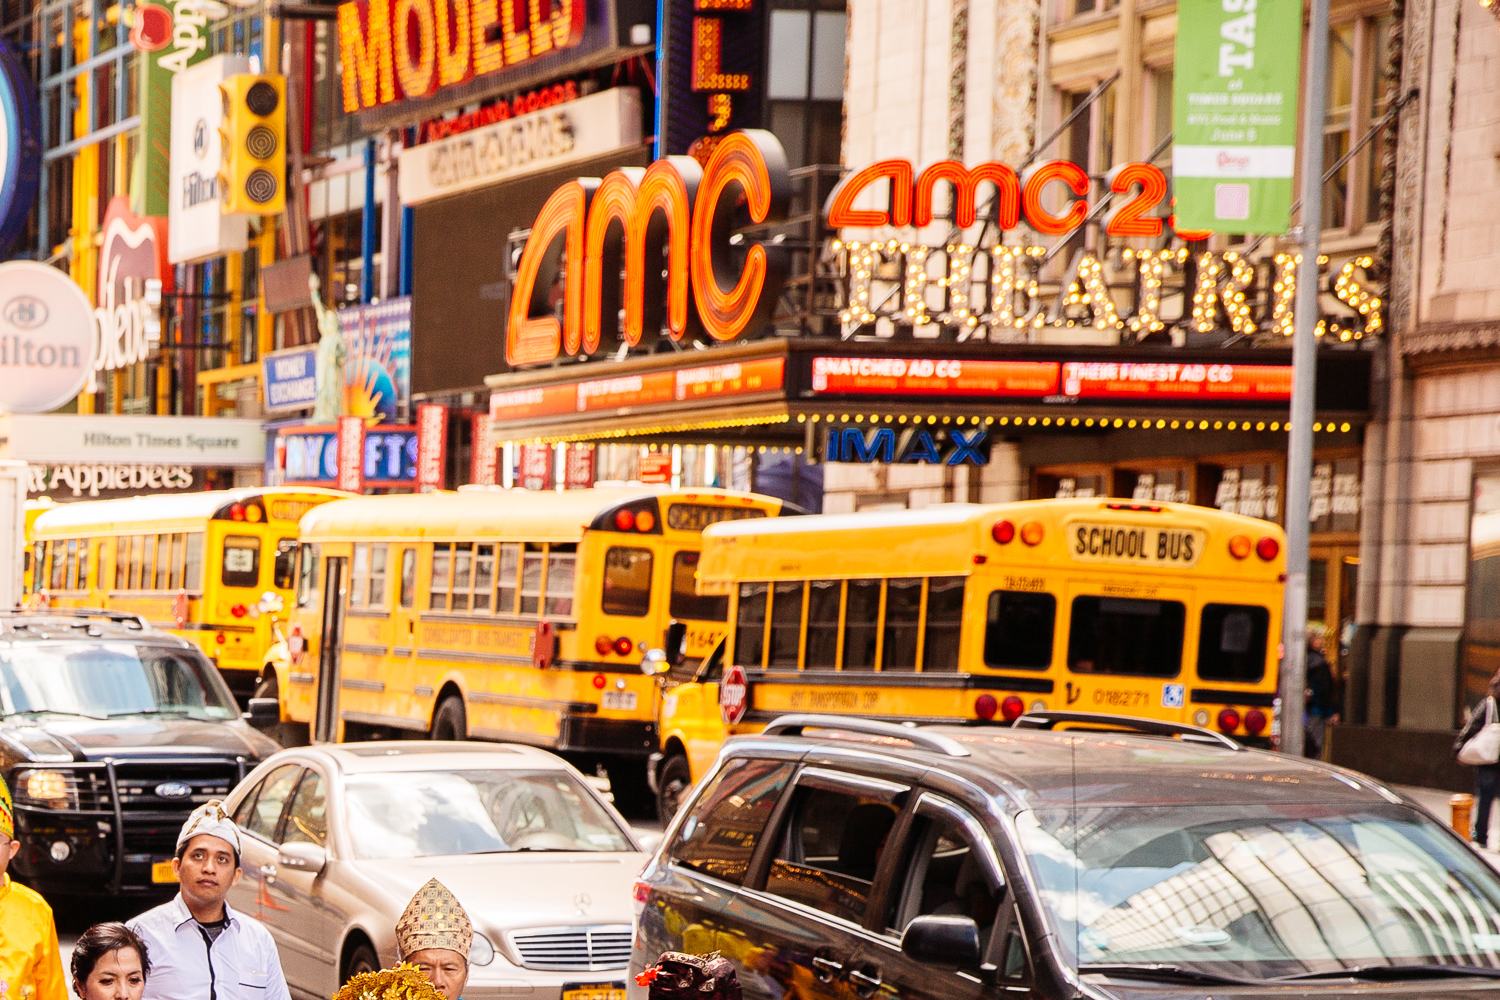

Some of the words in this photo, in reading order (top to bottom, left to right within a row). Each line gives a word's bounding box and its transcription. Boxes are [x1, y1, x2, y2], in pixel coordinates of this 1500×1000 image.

[1210, 127, 1246, 142] June
[84, 432, 131, 447] Hilton
[136, 433, 182, 448] Times
[186, 434, 239, 451] Square
[826, 427, 989, 466] IMAX
[286, 436, 325, 478] NY
[1076, 527, 1148, 559] SCHOOL
[1157, 532, 1195, 561] BUS
[725, 683, 746, 707] STOP
